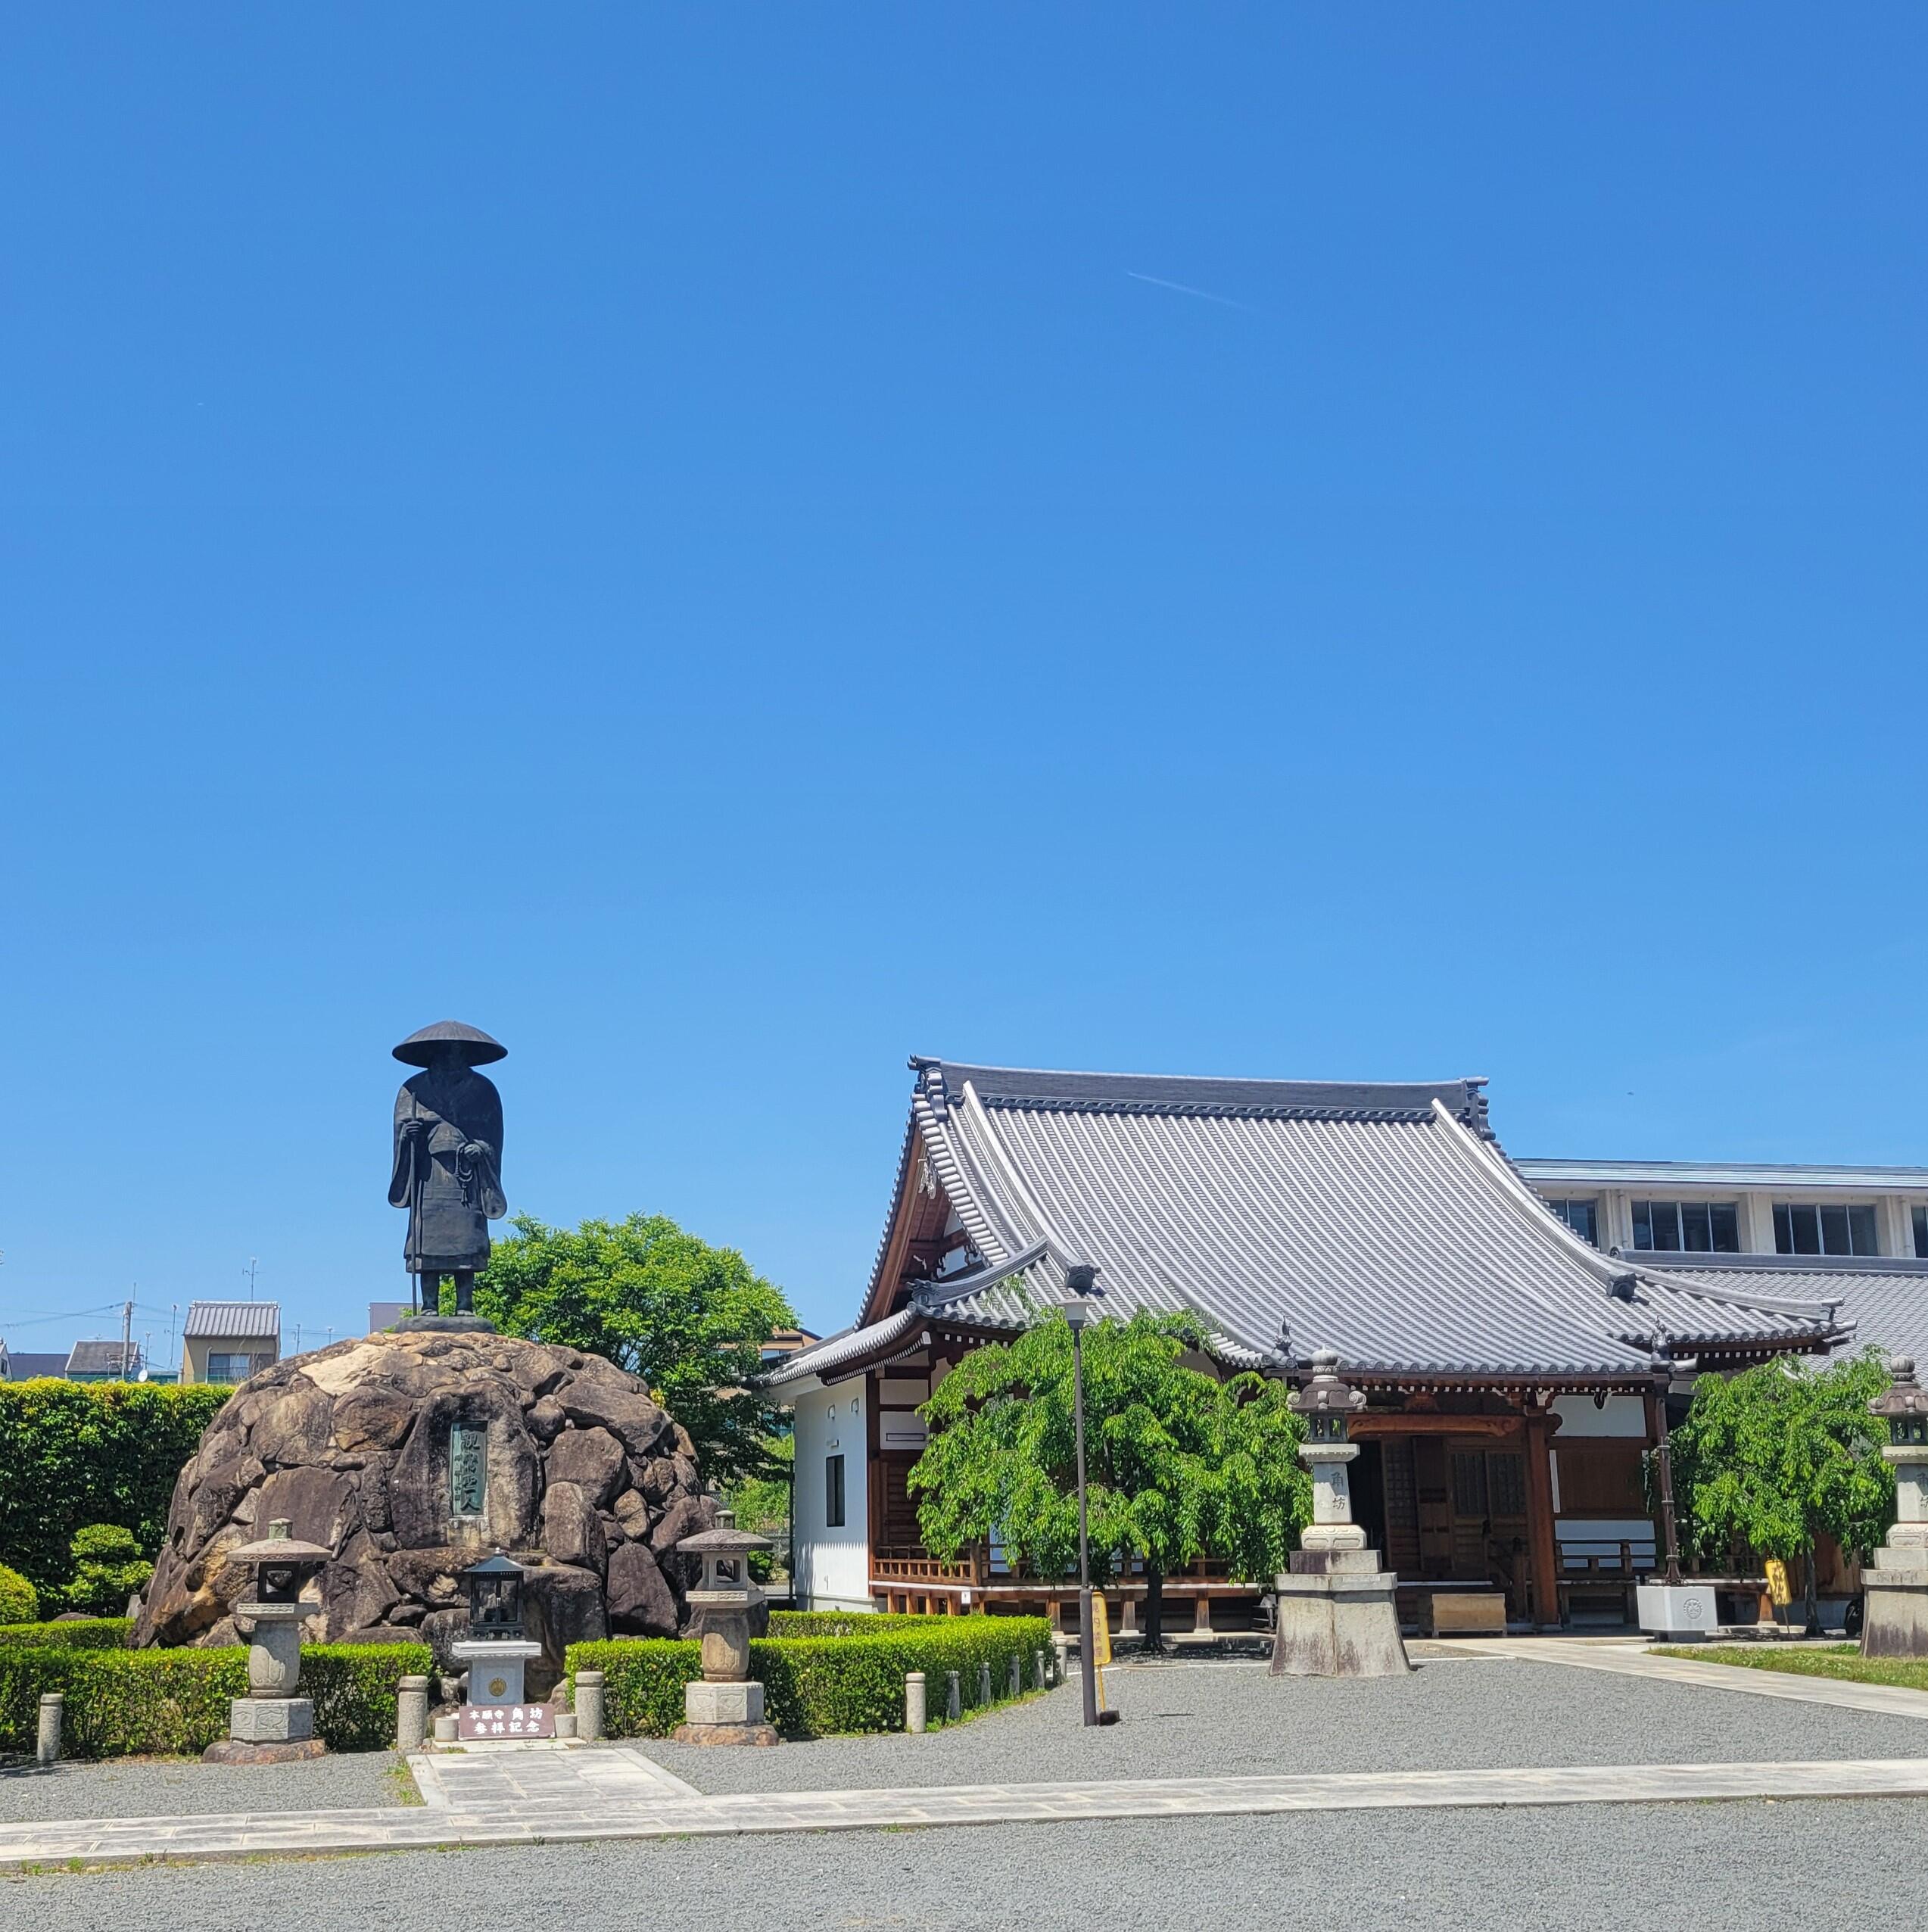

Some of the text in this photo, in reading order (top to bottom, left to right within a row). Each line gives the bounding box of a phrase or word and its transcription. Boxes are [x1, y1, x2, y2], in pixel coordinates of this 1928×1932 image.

[1331, 1472, 1346, 1510] 角坊
[469, 1707, 544, 1721] 本願寺 角坊
[474, 1720, 540, 1734] 参拝記念
